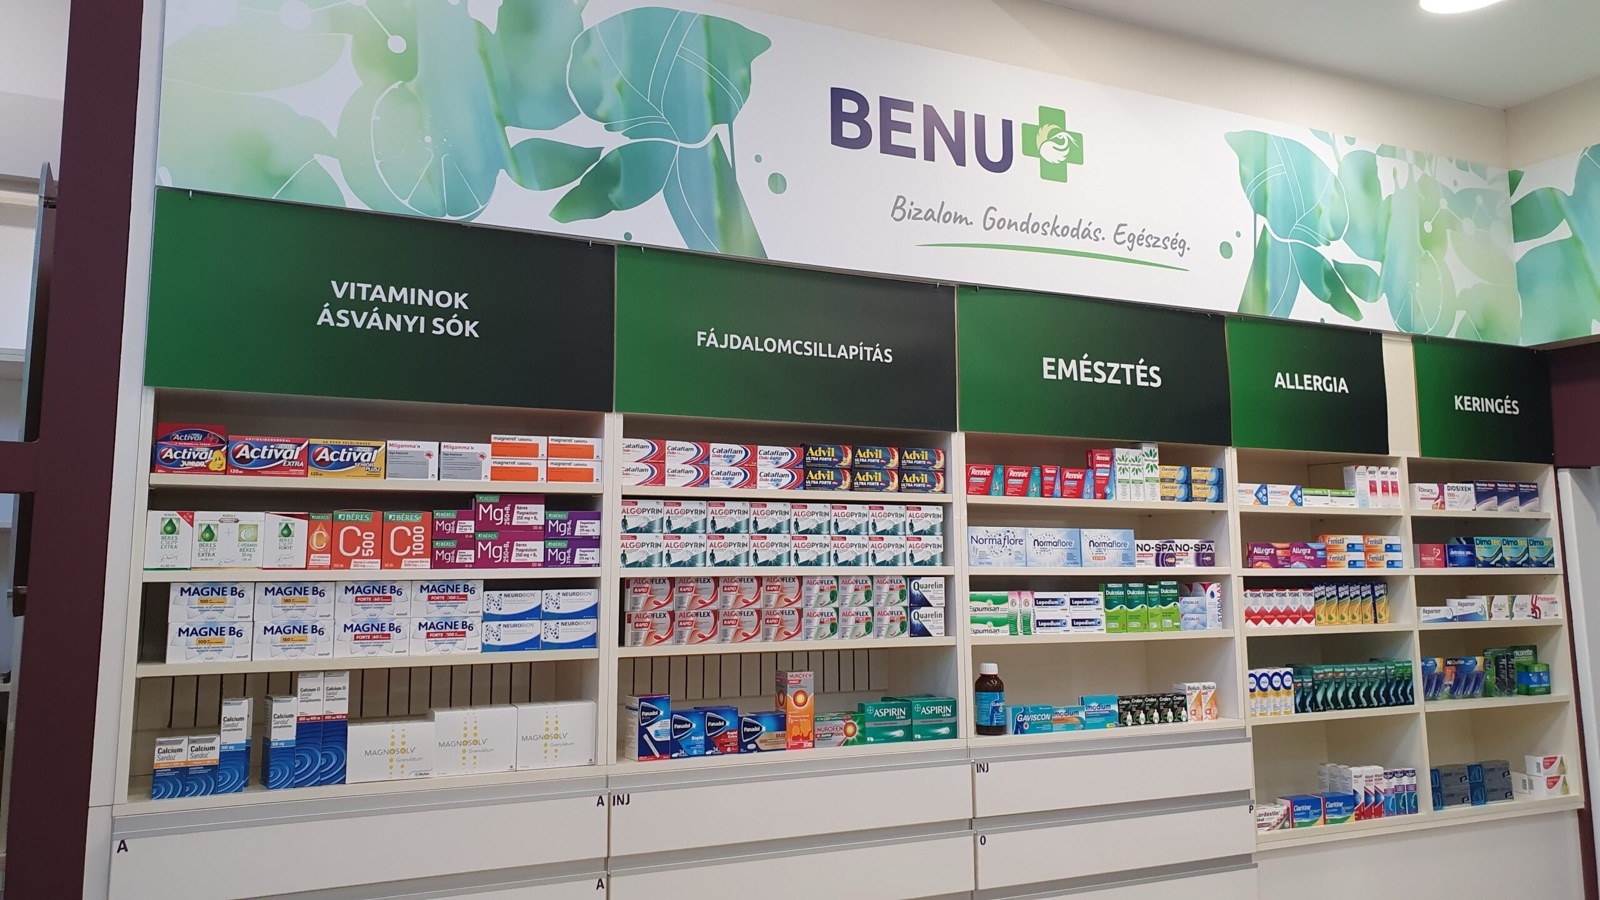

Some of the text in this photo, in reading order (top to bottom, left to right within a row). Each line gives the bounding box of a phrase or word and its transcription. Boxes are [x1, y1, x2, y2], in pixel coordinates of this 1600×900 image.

[830, 87, 1014, 173] BENU
[890, 195, 1190, 257] Bizalom. Gondoskodás. Egészség.
[331, 280, 469, 310] VITAMINOK
[316, 302, 480, 338] ÁSVÁNYI SÓK
[697, 328, 893, 363] FÁJDALOMCSILLAPÍTÁS
[1043, 353, 1162, 388] EMÉSZTÉS
[1274, 372, 1349, 394] ALLERGIA
[1454, 395, 1519, 415] KERINGÉS
[162, 447, 213, 460] Actival
[232, 443, 301, 460] Actival
[312, 446, 378, 463] Actival
[806, 447, 835, 457] Advil
[854, 449, 882, 459] Advil
[902, 450, 928, 460] Advil
[806, 470, 834, 480] Advil
[854, 472, 882, 482] Advil
[901, 474, 928, 483] Advil
[346, 513, 370, 521] BÉRES
[479, 504, 503, 525] Mg
[548, 520, 567, 536] Mg
[339, 526, 361, 556] C
[362, 531, 375, 556] 500
[390, 526, 411, 556] C
[412, 526, 425, 556] 1000
[970, 535, 1024, 547] Normaflore
[477, 542, 503, 563] Mg
[547, 548, 566, 564] Mg
[344, 585, 387, 595] MAGNE
[420, 584, 461, 594] MAGNE
[913, 581, 943, 590] Quarelin
[180, 586, 228, 596] MAGNE
[264, 586, 309, 596] MAGNE
[913, 611, 943, 620] Quarelin
[263, 625, 308, 635] MAGNE
[343, 623, 386, 633] MAGNE
[418, 621, 459, 631] MAGNE
[178, 627, 226, 637] MAGNE
[874, 707, 906, 717] ASPIRIN
[921, 706, 952, 715] ASPIRIN
[1017, 714, 1050, 722] GAVISCON
[522, 732, 568, 742] MAGNOSOLV
[438, 738, 487, 748] MAGNOSOLV
[364, 746, 416, 756] MAGNOSOLV
[976, 763, 989, 773] INJ
[597, 795, 604, 807] A
[613, 794, 630, 806] INJ
[1249, 805, 1253, 814] P
[117, 839, 128, 853] A
[596, 878, 604, 890] A
